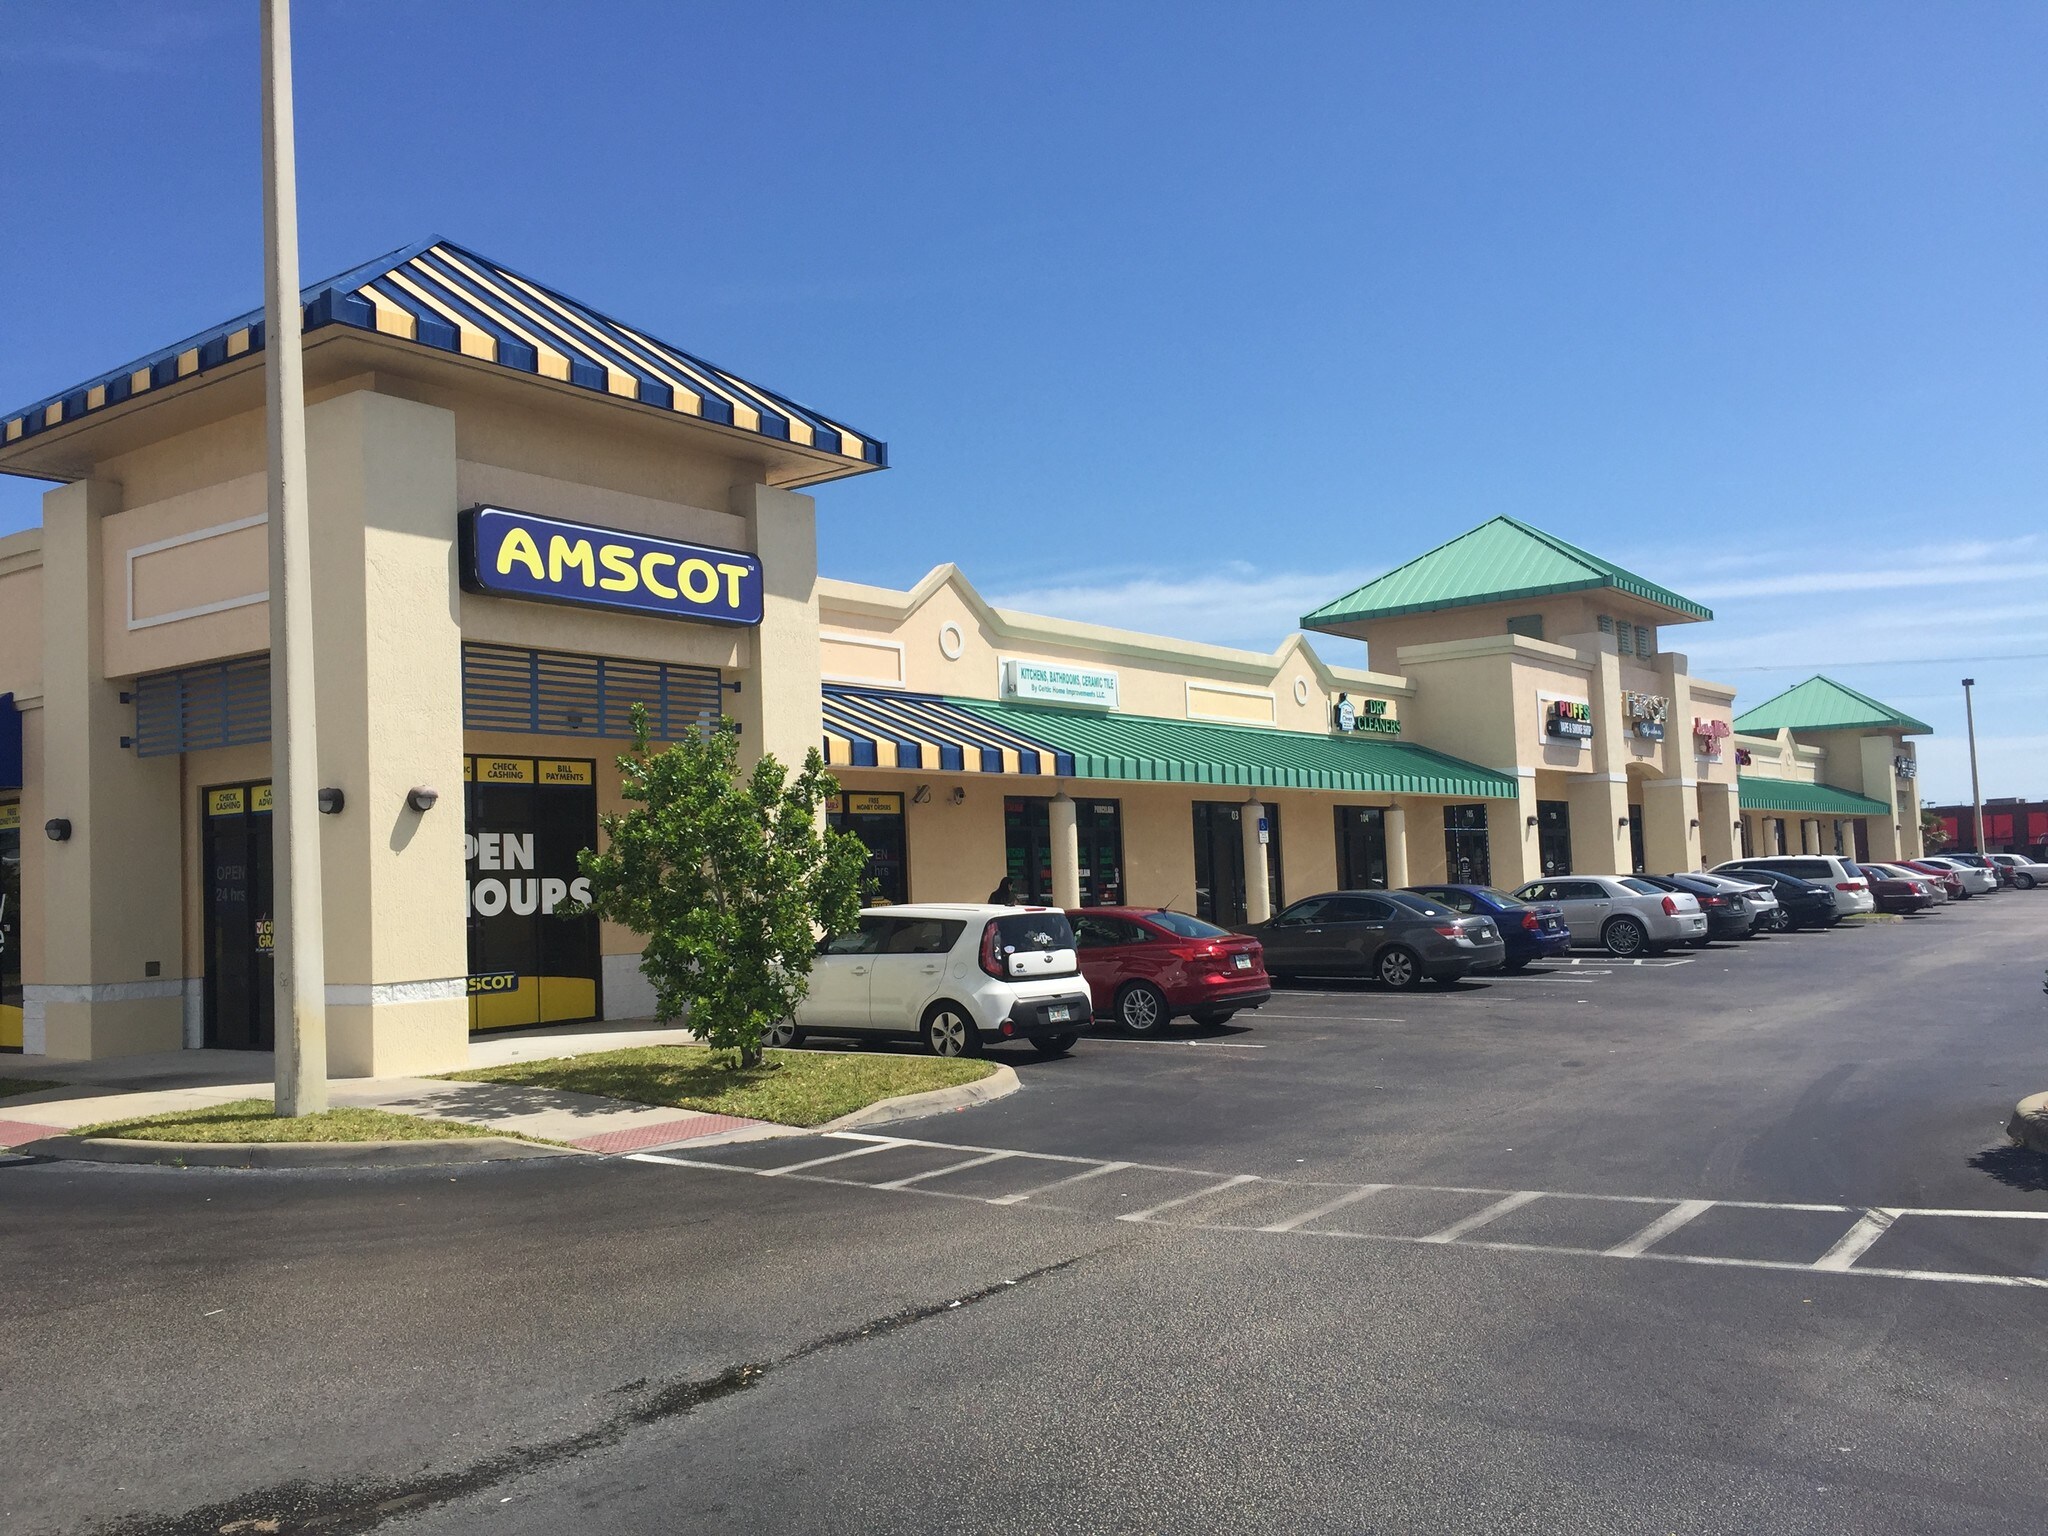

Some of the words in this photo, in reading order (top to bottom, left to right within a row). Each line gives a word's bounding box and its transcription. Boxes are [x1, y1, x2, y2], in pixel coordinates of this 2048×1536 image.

[497, 528, 748, 608] AMSCOT
[1082, 675, 1103, 688] CERAMIC
[1103, 677, 1114, 689] TILE
[1031, 684, 1037, 693] By
[1052, 686, 1066, 694] Home
[1066, 687, 1096, 698] Improvements
[1370, 700, 1387, 714] DRY
[1560, 700, 1590, 720] PUFFS
[1357, 716, 1400, 733] CLEANERS
[492, 762, 517, 770] CHECK
[487, 770, 523, 779] CASHING
[546, 773, 583, 781] PAYMENTS
[219, 793, 236, 801] CHECK
[215, 801, 240, 811] CASHING
[217, 865, 246, 880] OPEN
[875, 865, 889, 875] hrs
[216, 888, 228, 901] 24
[230, 887, 246, 901] hrs
[468, 975, 515, 991] SCOT
